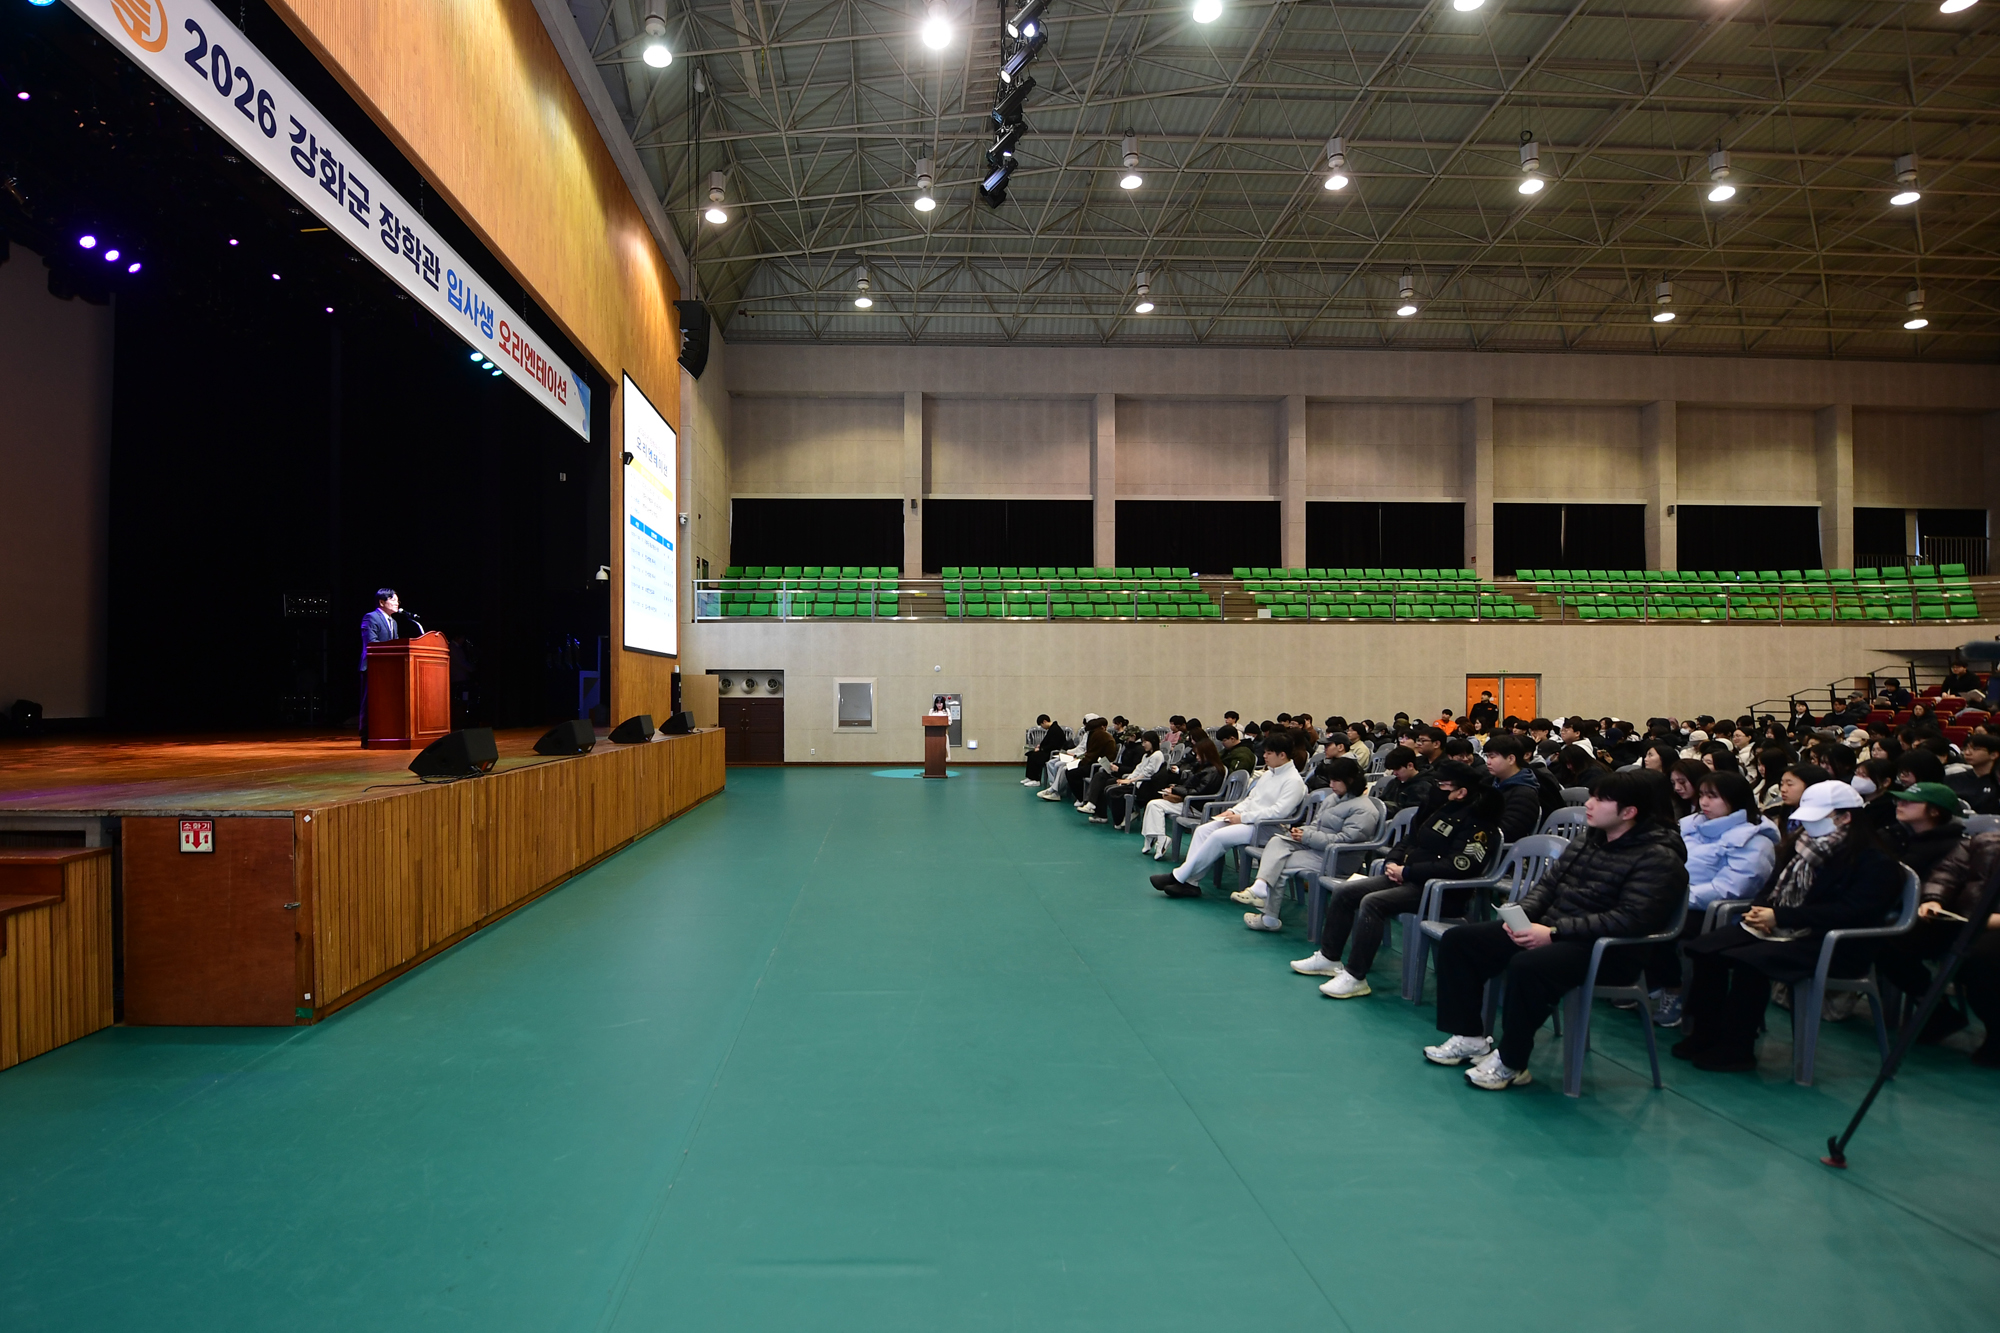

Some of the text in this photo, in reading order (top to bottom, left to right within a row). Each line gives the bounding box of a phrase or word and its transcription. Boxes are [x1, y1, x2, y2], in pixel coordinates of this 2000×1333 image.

[185, 18, 567, 406] 2026 강화군 장학관 입사생 오리엔테이션
[636, 437, 668, 477] 오리엔테이션
[183, 822, 210, 831] 소화기
